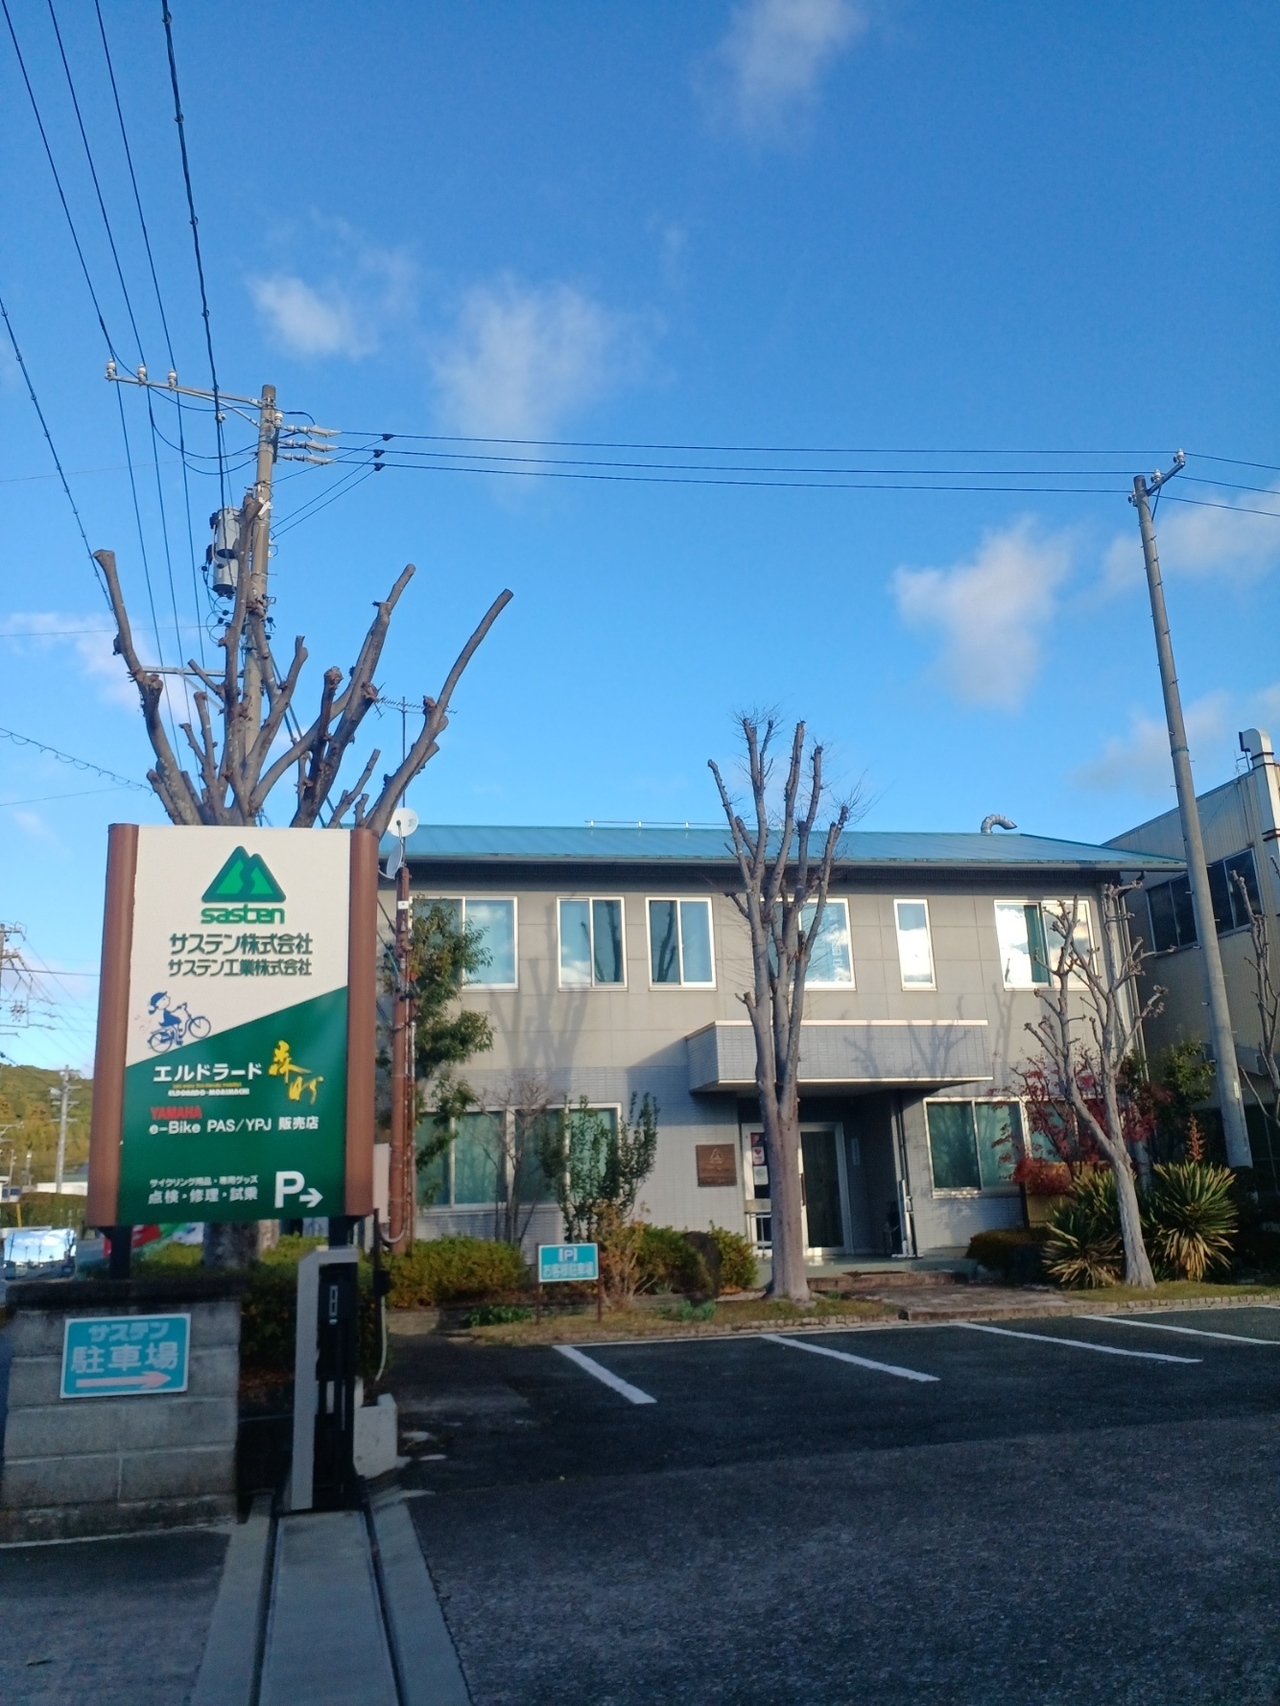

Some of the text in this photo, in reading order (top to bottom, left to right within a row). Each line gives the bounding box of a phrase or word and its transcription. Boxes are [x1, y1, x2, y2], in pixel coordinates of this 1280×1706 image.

[201, 904, 285, 924] sasten
[170, 932, 313, 955] サステン株式会社
[168, 958, 312, 977] サステン工業株式会社
[153, 1062, 262, 1081] エルドラード
[151, 1106, 202, 1119] YAMAHA
[149, 1119, 201, 1135] e-Bike
[278, 1116, 320, 1131] 販売店
[274, 1171, 305, 1208] P
[88, 1322, 169, 1342] サステン
[71, 1342, 179, 1374] 駐車場
